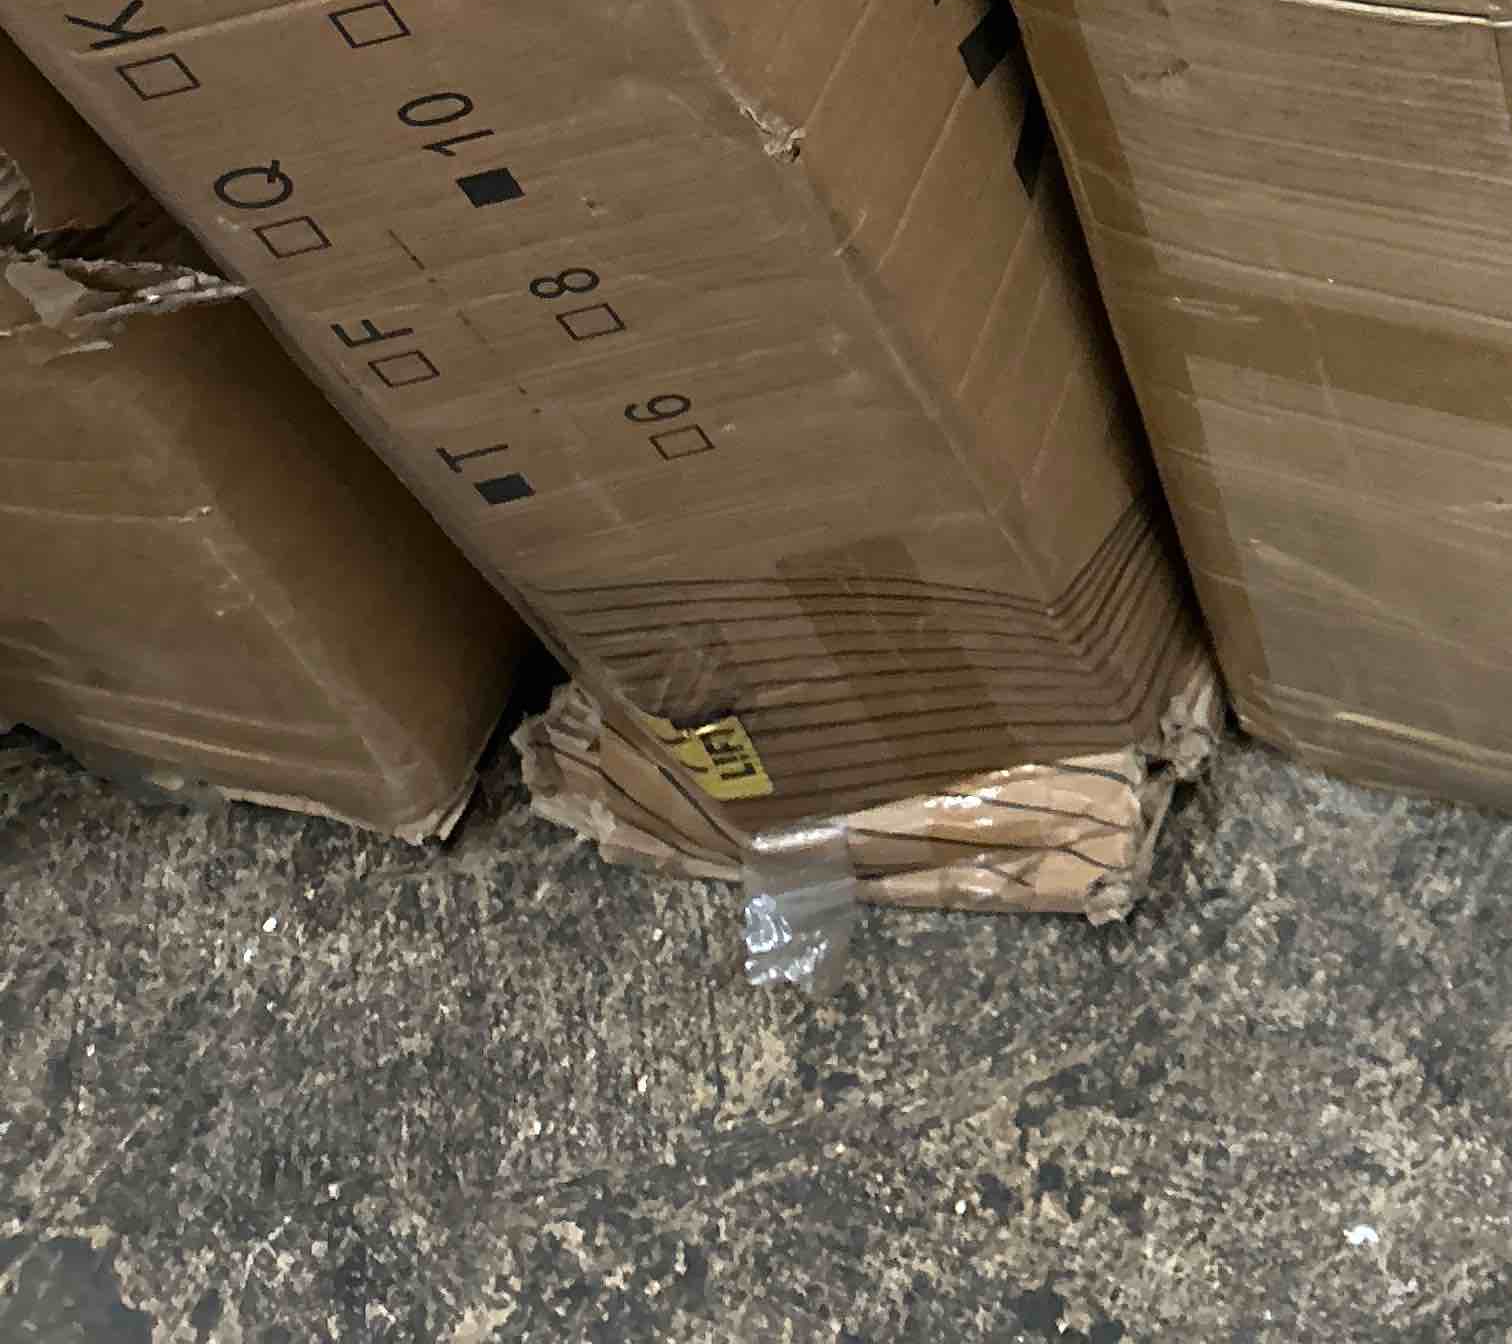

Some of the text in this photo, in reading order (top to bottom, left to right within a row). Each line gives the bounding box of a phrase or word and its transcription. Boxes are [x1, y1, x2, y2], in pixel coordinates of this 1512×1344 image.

[397, 92, 495, 157] 10
[213, 160, 293, 209] Q
[529, 268, 599, 298] 8
[330, 319, 414, 348] F
[624, 394, 691, 422] 6
[436, 444, 508, 473] T
